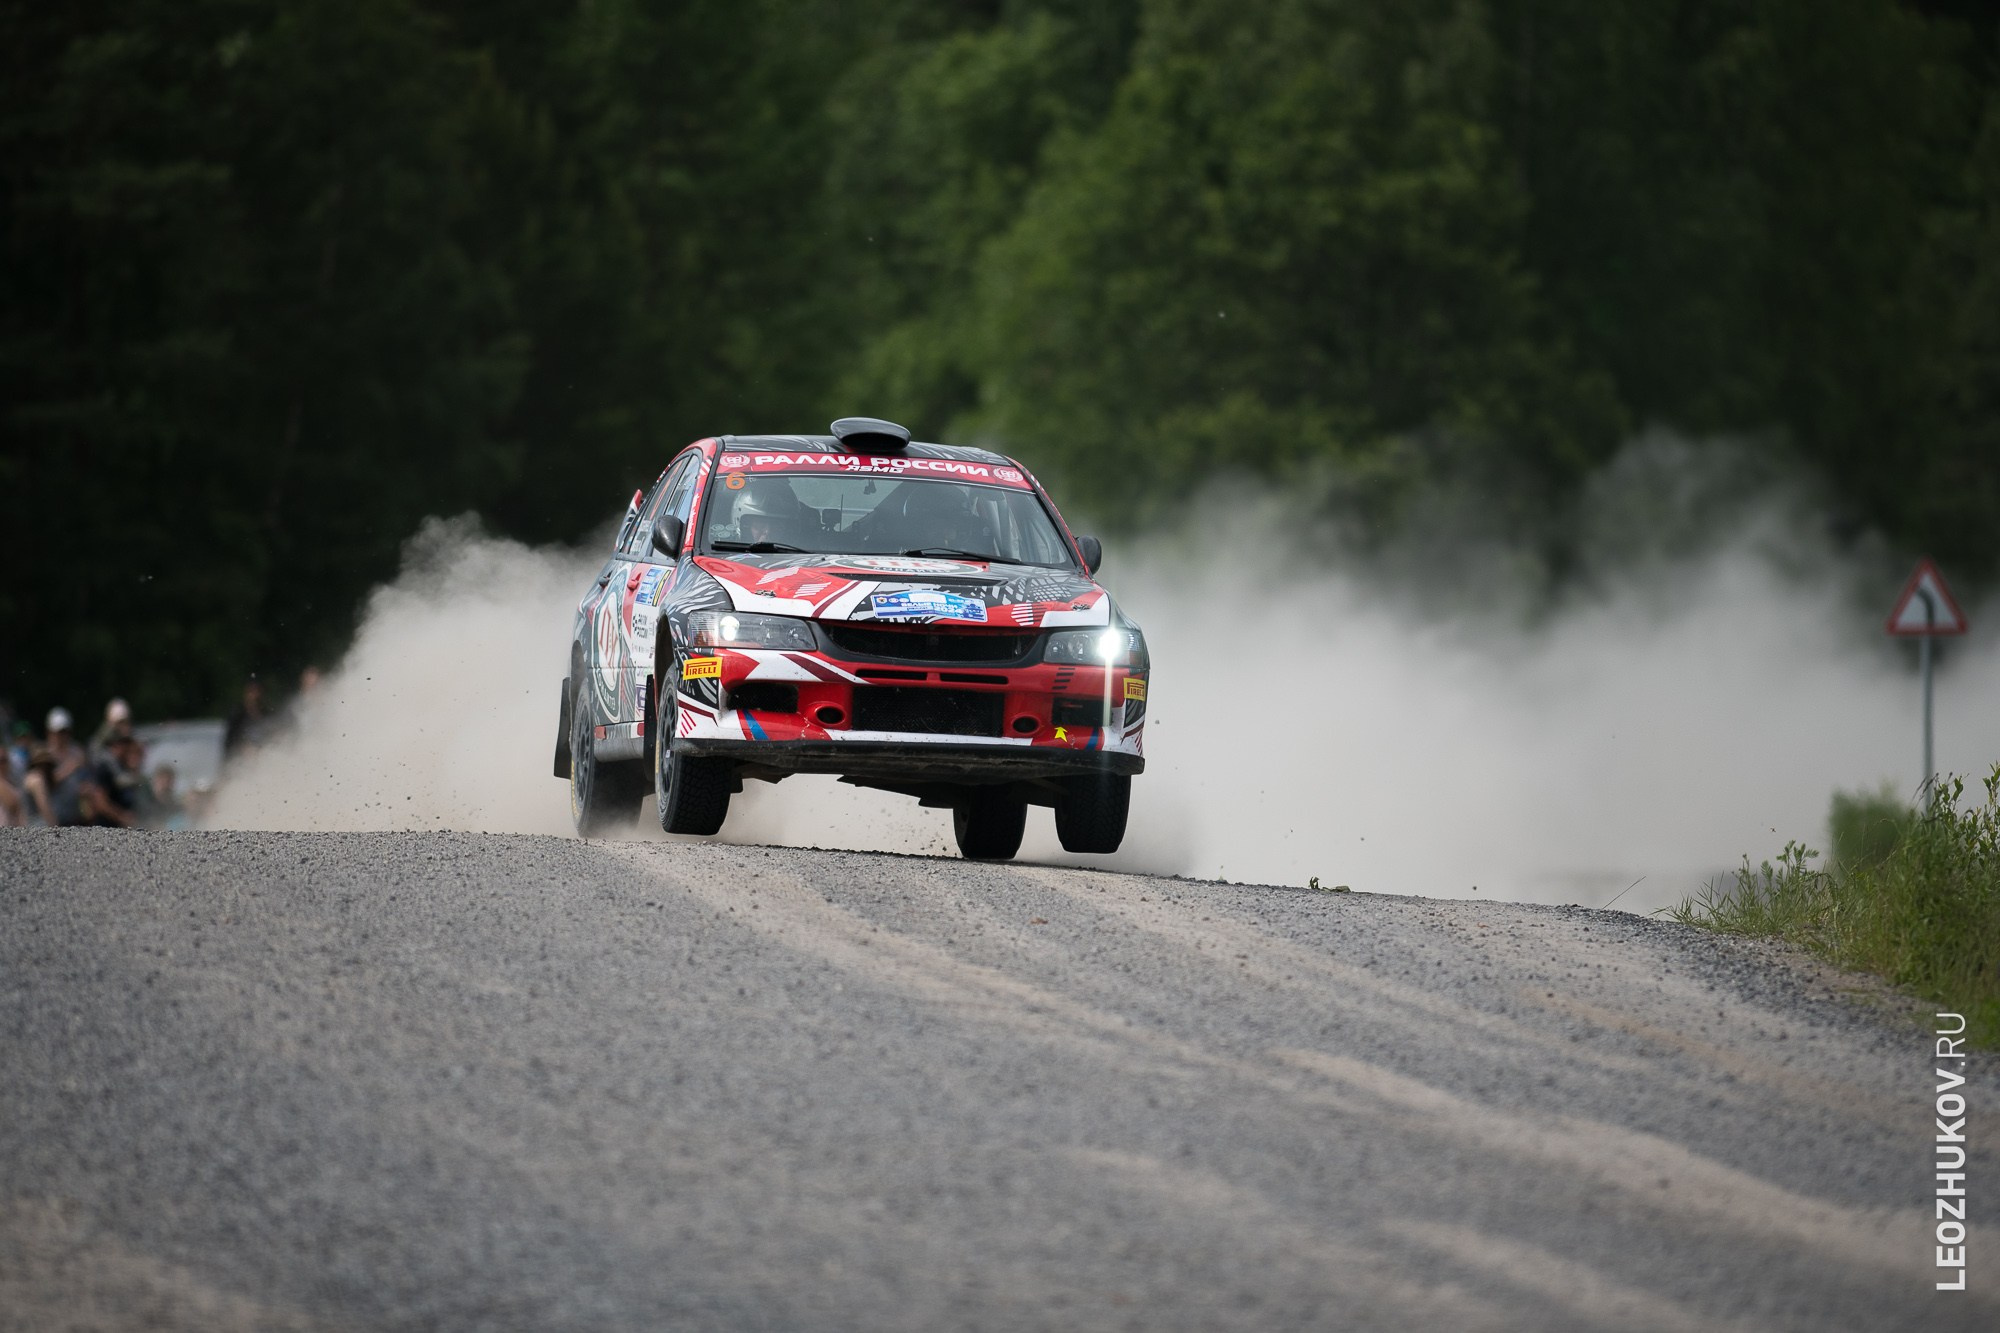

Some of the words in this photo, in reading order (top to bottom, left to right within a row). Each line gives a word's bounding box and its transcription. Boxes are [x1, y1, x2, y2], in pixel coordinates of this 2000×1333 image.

[754, 455, 860, 466] РАЛЛИ
[870, 457, 989, 477] РОССИИ
[725, 472, 746, 490] 6
[686, 661, 717, 676] PIRELLI
